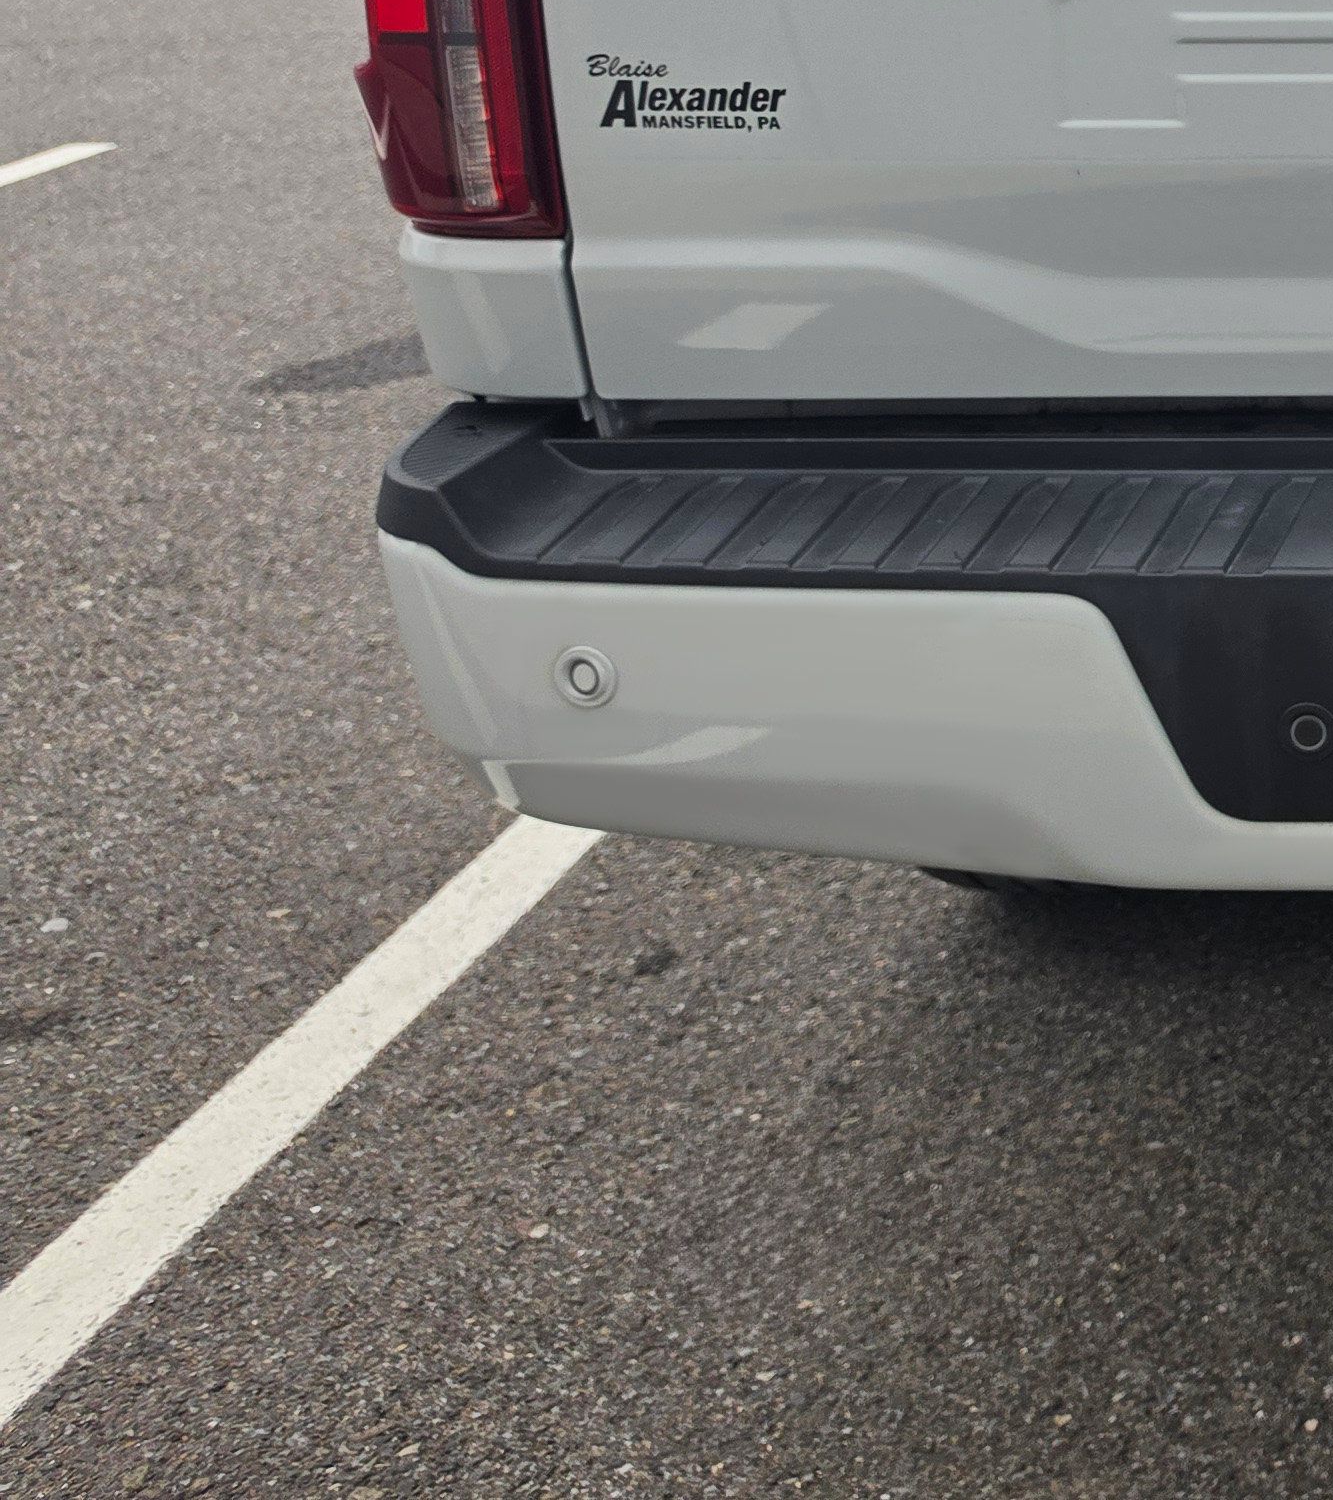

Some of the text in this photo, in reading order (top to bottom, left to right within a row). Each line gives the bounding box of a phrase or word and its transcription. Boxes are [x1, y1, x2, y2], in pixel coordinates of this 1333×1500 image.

[586, 53, 669, 78] Blaise
[600, 79, 787, 128] Alexander
[642, 115, 781, 133] MANSFIELD, PA
